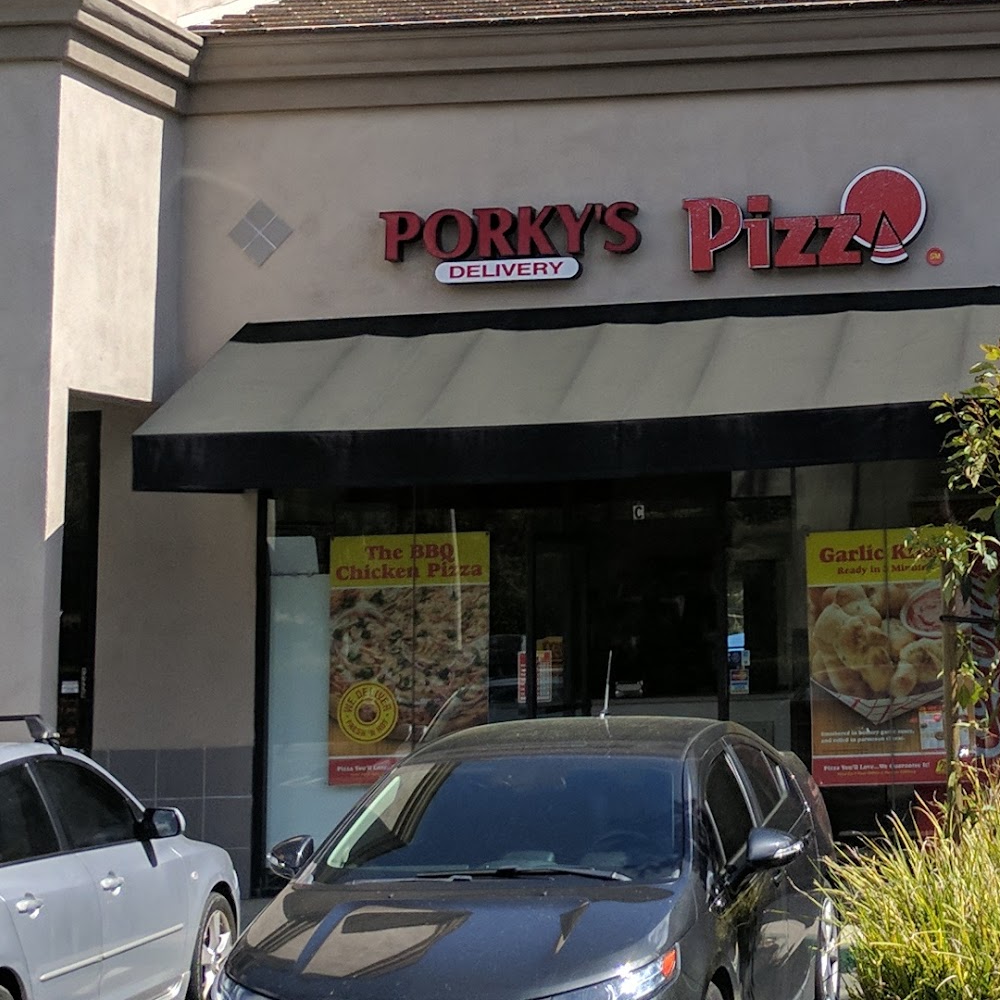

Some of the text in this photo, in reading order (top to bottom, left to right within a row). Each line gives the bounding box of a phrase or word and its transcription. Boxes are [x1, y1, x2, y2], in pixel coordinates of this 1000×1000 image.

[379, 201, 640, 263] PORKY'S
[449, 261, 564, 279] DELIVERY
[365, 543, 455, 562] The BBQ
[819, 544, 884, 563] Garlic
[336, 562, 483, 580] Chicken Pizza
[837, 565, 867, 576] Ready
